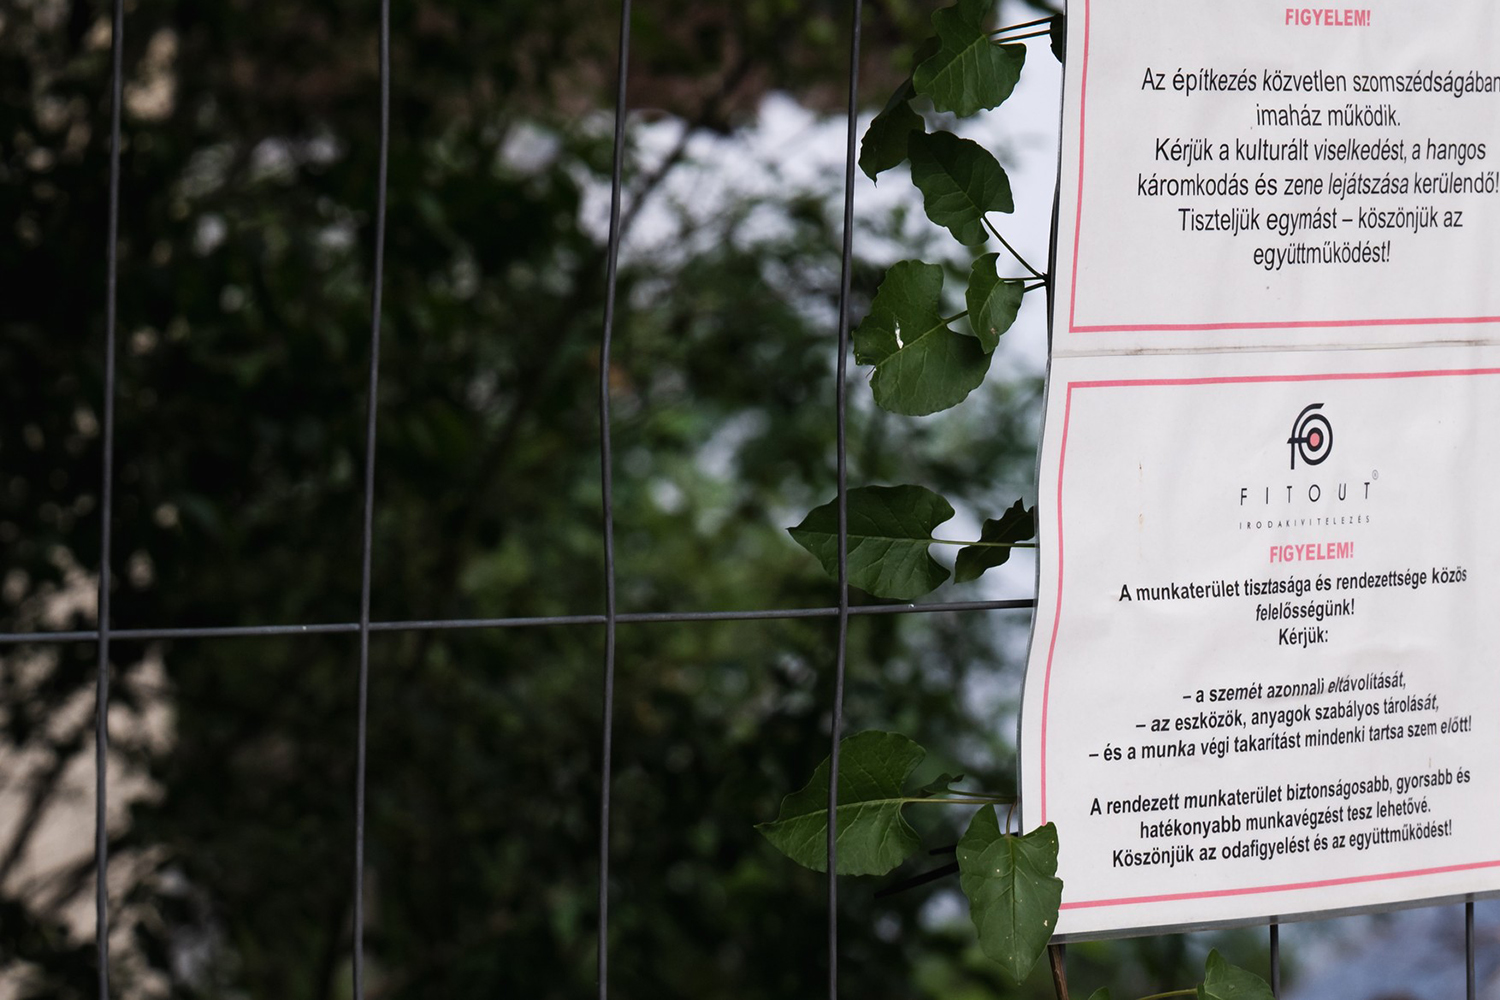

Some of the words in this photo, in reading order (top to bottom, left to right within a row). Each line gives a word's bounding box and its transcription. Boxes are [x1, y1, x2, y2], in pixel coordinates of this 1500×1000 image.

[1285, 8, 1371, 27] FIGYELEM!
[1141, 67, 1166, 90] Az
[1172, 67, 1257, 97] építkezés
[1263, 69, 1346, 92] közvetlen
[1256, 103, 1322, 127] imaház
[1328, 103, 1400, 126] működik.
[1155, 138, 1213, 167] Kérjük
[1219, 143, 1229, 161] a
[1236, 138, 1309, 162] kulturált
[1314, 138, 1407, 164] viselkedést,
[1412, 143, 1421, 160] a
[1426, 138, 1486, 166] hangos
[1138, 172, 1249, 197] káromkodás
[1255, 172, 1277, 196] és
[1284, 178, 1323, 196] zene
[1328, 172, 1409, 201] lejátszása
[1414, 171, 1499, 194] kerülendő!
[1178, 207, 1260, 237] Tiszteljük
[1266, 206, 1337, 236] egymást
[1358, 205, 1438, 234] köszönjük
[1443, 211, 1463, 228] az
[1253, 240, 1390, 271] együttműködést!
[1239, 515, 1370, 529] IRODAKIVITELEZÉS
[1270, 542, 1354, 563] FIGYELEM!
[1118, 584, 1132, 602] A
[1136, 580, 1240, 601] munkaterület
[1244, 575, 1313, 598] tisztasága
[1315, 574, 1332, 592] és
[1335, 568, 1427, 591] rendezettsége
[1432, 566, 1467, 584] közös
[1256, 598, 1354, 622] felelősségünk!
[1279, 626, 1328, 649] Kérjük:
[1195, 690, 1205, 703] a
[1209, 682, 1262, 703] szemét
[1267, 676, 1324, 699] azonnali
[1327, 671, 1406, 694] eltávolítását,
[1151, 719, 1170, 732] az
[1175, 709, 1247, 731] eszközök,
[1251, 705, 1311, 728] anyagok
[1315, 700, 1380, 722] szabályos
[1383, 693, 1439, 714] tárolását,
[1103, 743, 1122, 761] és
[1125, 746, 1136, 760] a
[1141, 739, 1195, 759] munka
[1200, 737, 1229, 759] végi
[1234, 732, 1301, 753] takarítást
[1305, 725, 1365, 747] mindenki
[1369, 724, 1404, 741] tartsa
[1407, 722, 1437, 738] szem
[1440, 715, 1471, 734] előtt!
[1090, 798, 1102, 816] A
[1106, 793, 1180, 815] rendezett
[1183, 785, 1283, 809] munkaterület
[1286, 775, 1392, 801] biztonságosabb,
[1396, 768, 1453, 795] gyorsabb
[1456, 766, 1470, 784] és
[1140, 815, 1241, 840] hatékonyabb
[1243, 806, 1344, 832] munkavégzést
[1347, 805, 1373, 822] tesz
[1376, 796, 1431, 818] lehetővé.
[1113, 845, 1195, 868] Köszönjük
[1198, 847, 1217, 861] az
[1221, 837, 1310, 860] odafigyelést
[1313, 833, 1328, 851] és
[1332, 835, 1346, 849] az
[1349, 819, 1452, 851] együttműködést!
